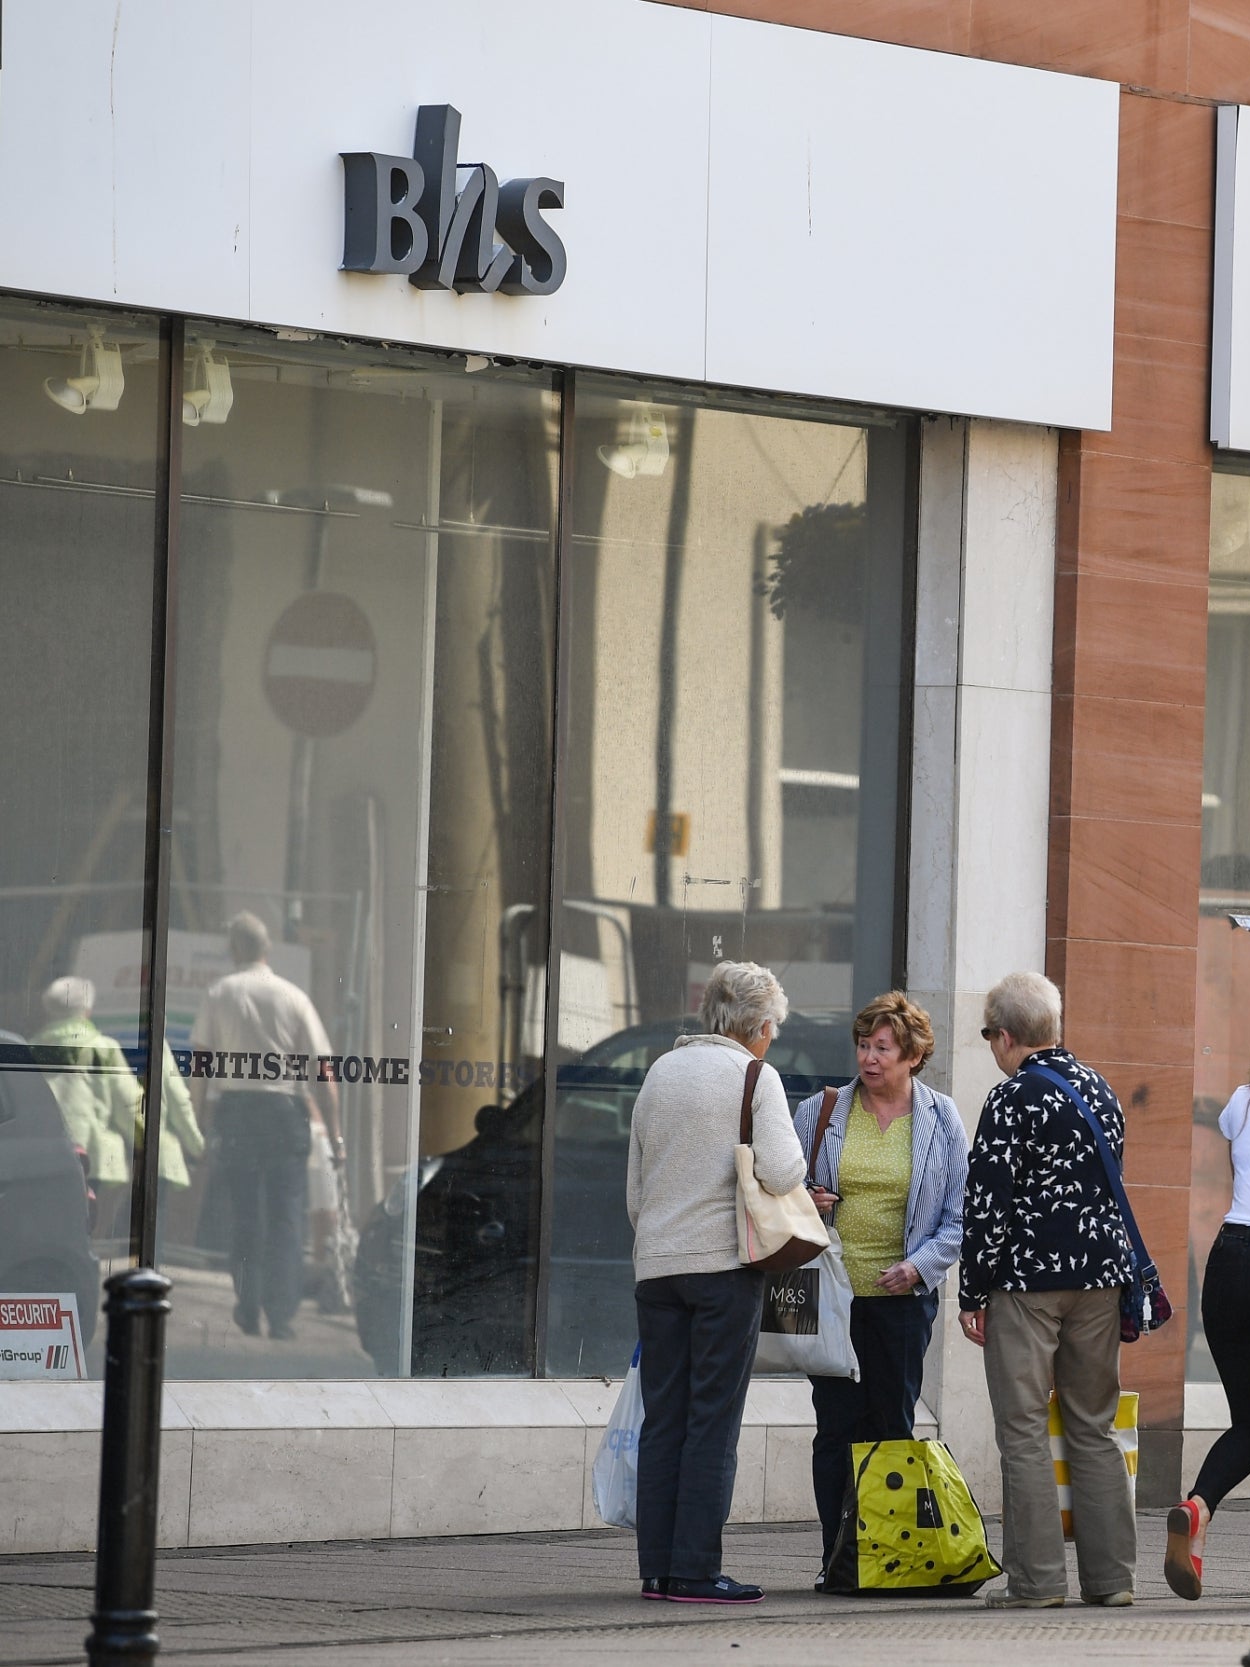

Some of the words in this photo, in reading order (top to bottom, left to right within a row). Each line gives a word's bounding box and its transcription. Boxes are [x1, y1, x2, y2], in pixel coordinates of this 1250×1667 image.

[170, 1050, 309, 1081] BRITISH
[317, 1055, 409, 1085] HOME
[770, 1286, 806, 1305] M&S
[1, 1303, 59, 1325] SECURITY
